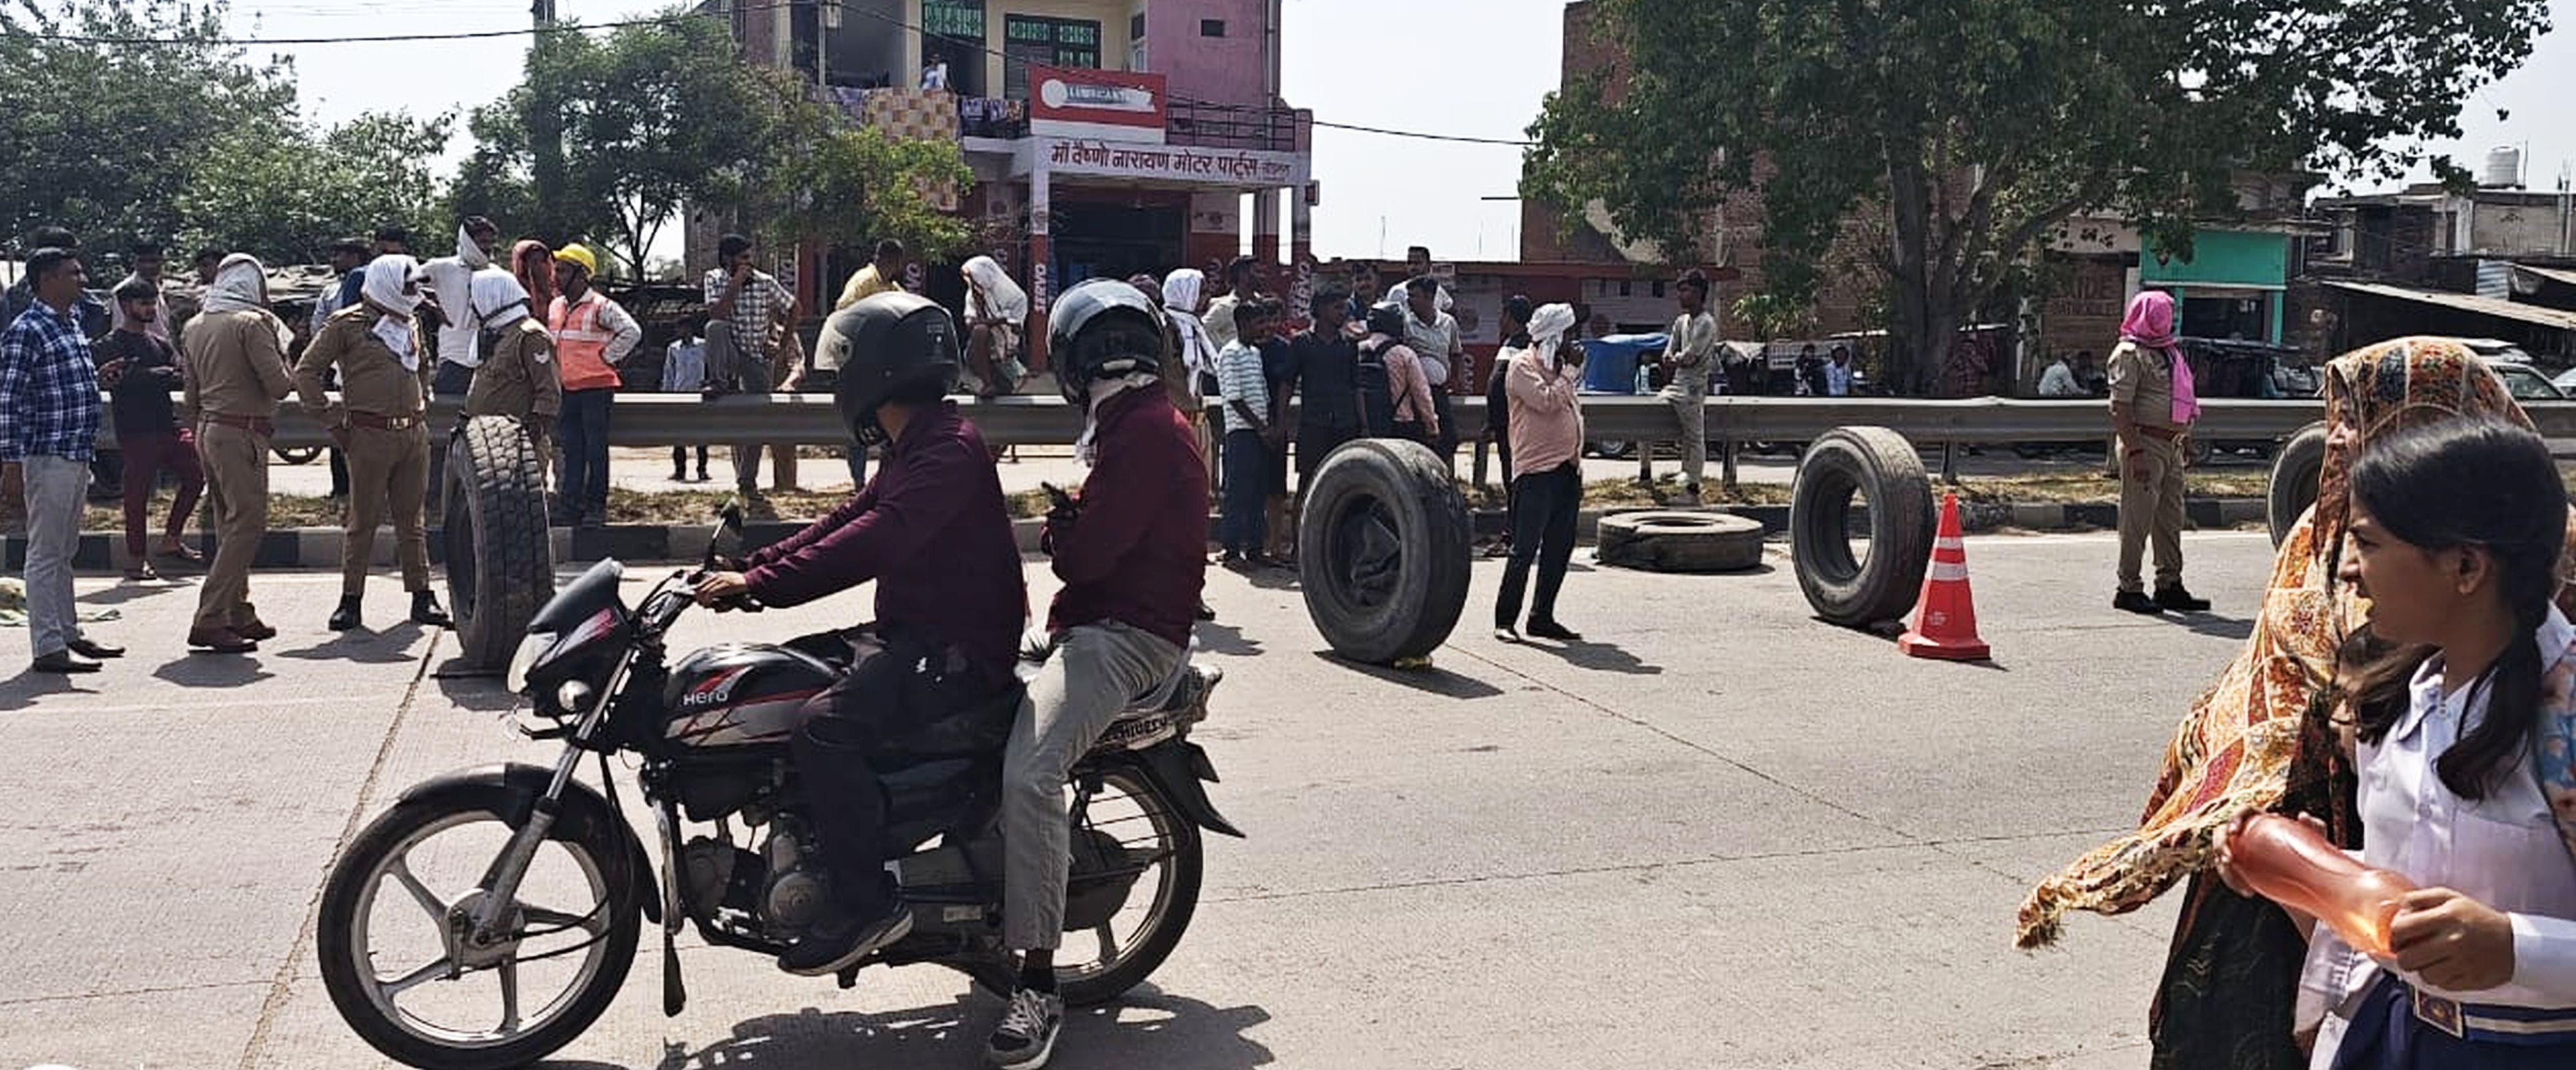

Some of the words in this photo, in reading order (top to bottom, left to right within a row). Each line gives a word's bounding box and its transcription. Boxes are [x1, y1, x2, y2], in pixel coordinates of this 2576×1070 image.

[1112, 149, 1169, 170] नारायण
[1174, 148, 1213, 174] मोटर
[1034, 264, 1046, 315] SERVO
